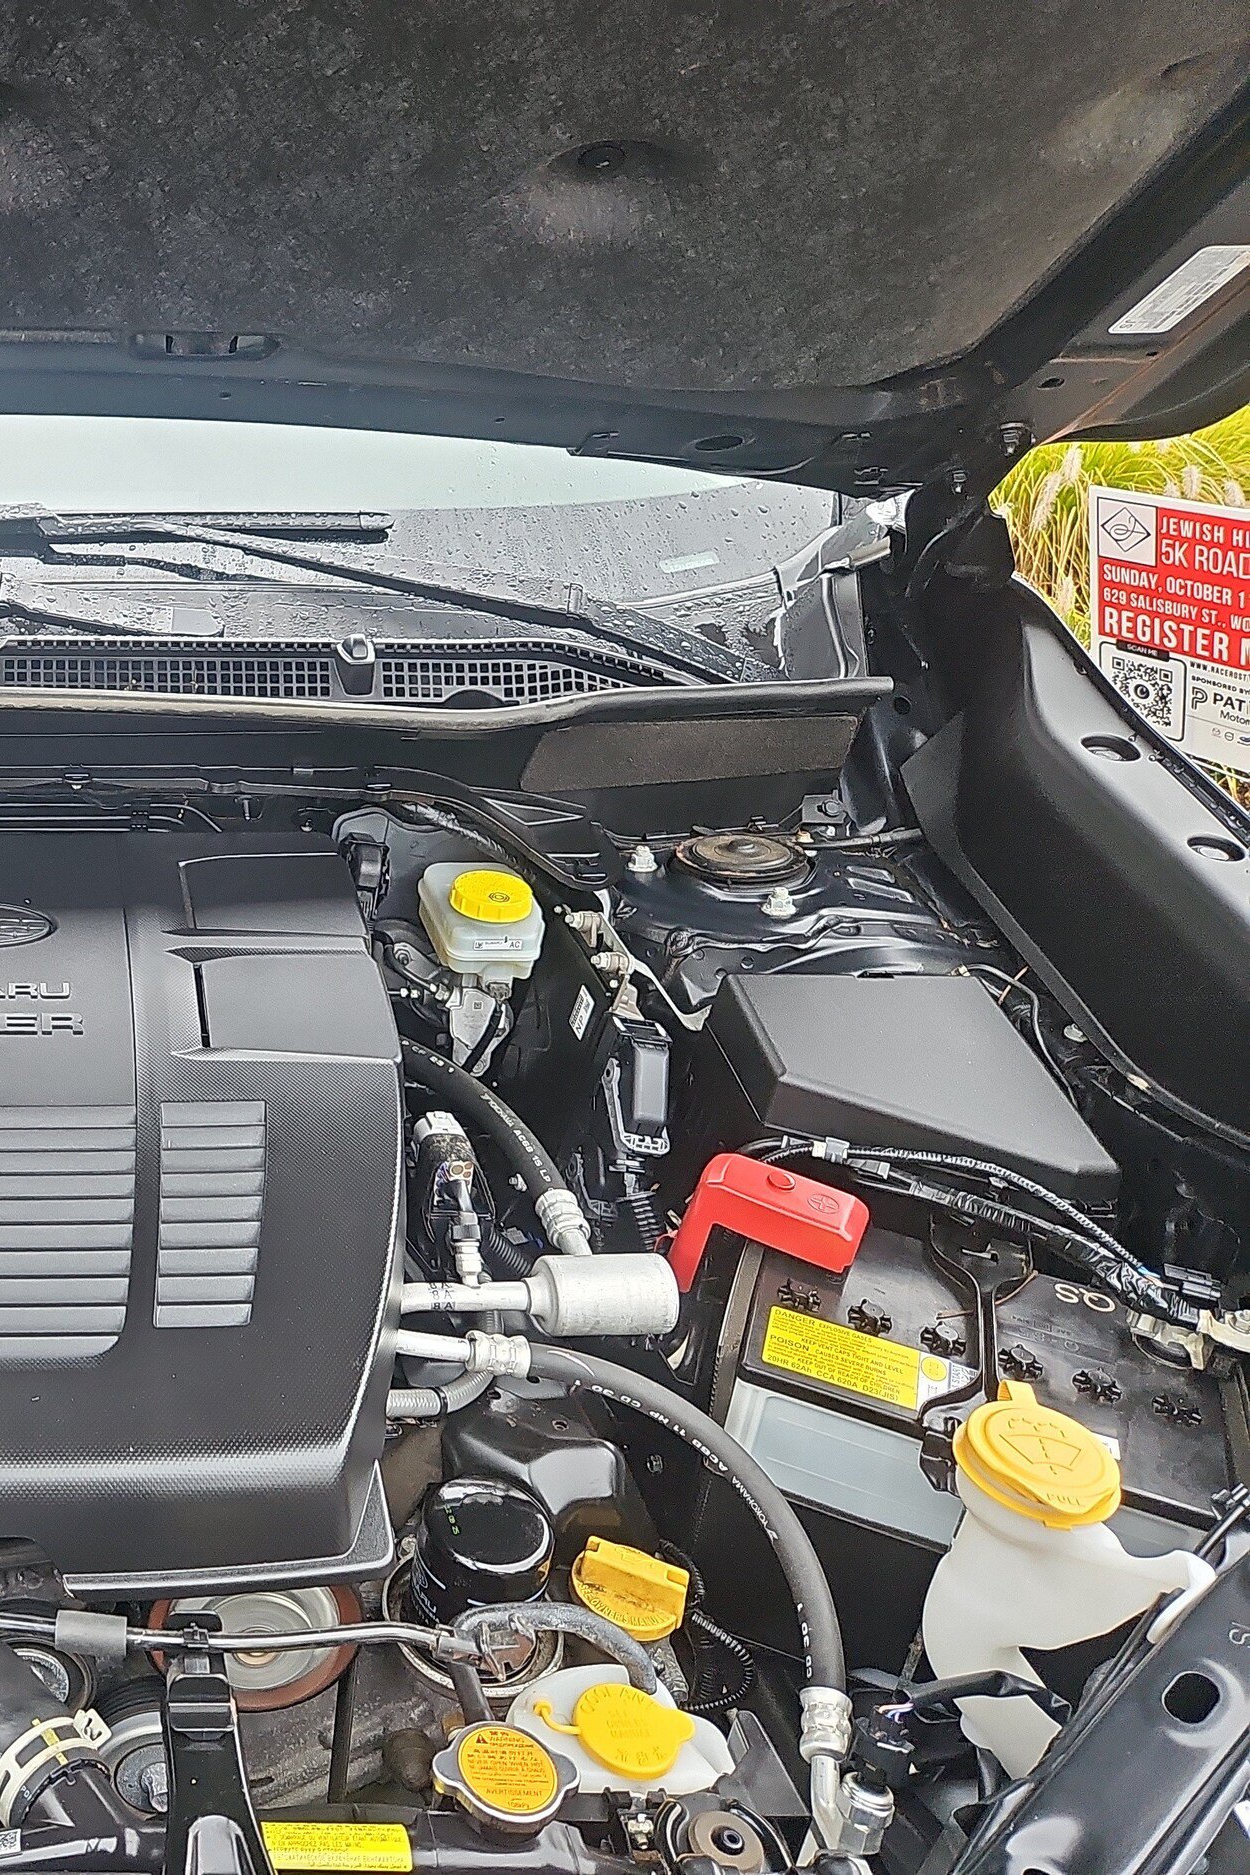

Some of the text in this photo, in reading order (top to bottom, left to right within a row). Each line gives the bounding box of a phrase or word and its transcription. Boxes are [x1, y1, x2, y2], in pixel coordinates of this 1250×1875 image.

[1160, 516, 1225, 544] JEWISH
[1161, 538, 1189, 568] 5K
[1103, 563, 1163, 594] SUNDAY,
[1165, 576, 1233, 606] OCTOBER
[1103, 586, 1127, 606] 629
[1130, 592, 1198, 620] SALISBURY
[1104, 606, 1229, 662] REGISTER
[1191, 675, 1237, 692] SPONSORED
[1213, 692, 1250, 715] PAT
[773, 1308, 816, 1326] DANGER
[769, 1333, 810, 1352] POISON
[817, 1341, 834, 1351] VENT
[834, 1346, 851, 1357] CAPS
[816, 1370, 835, 1383] CCA
[730, 1475, 769, 1529] YOKOHAMA
